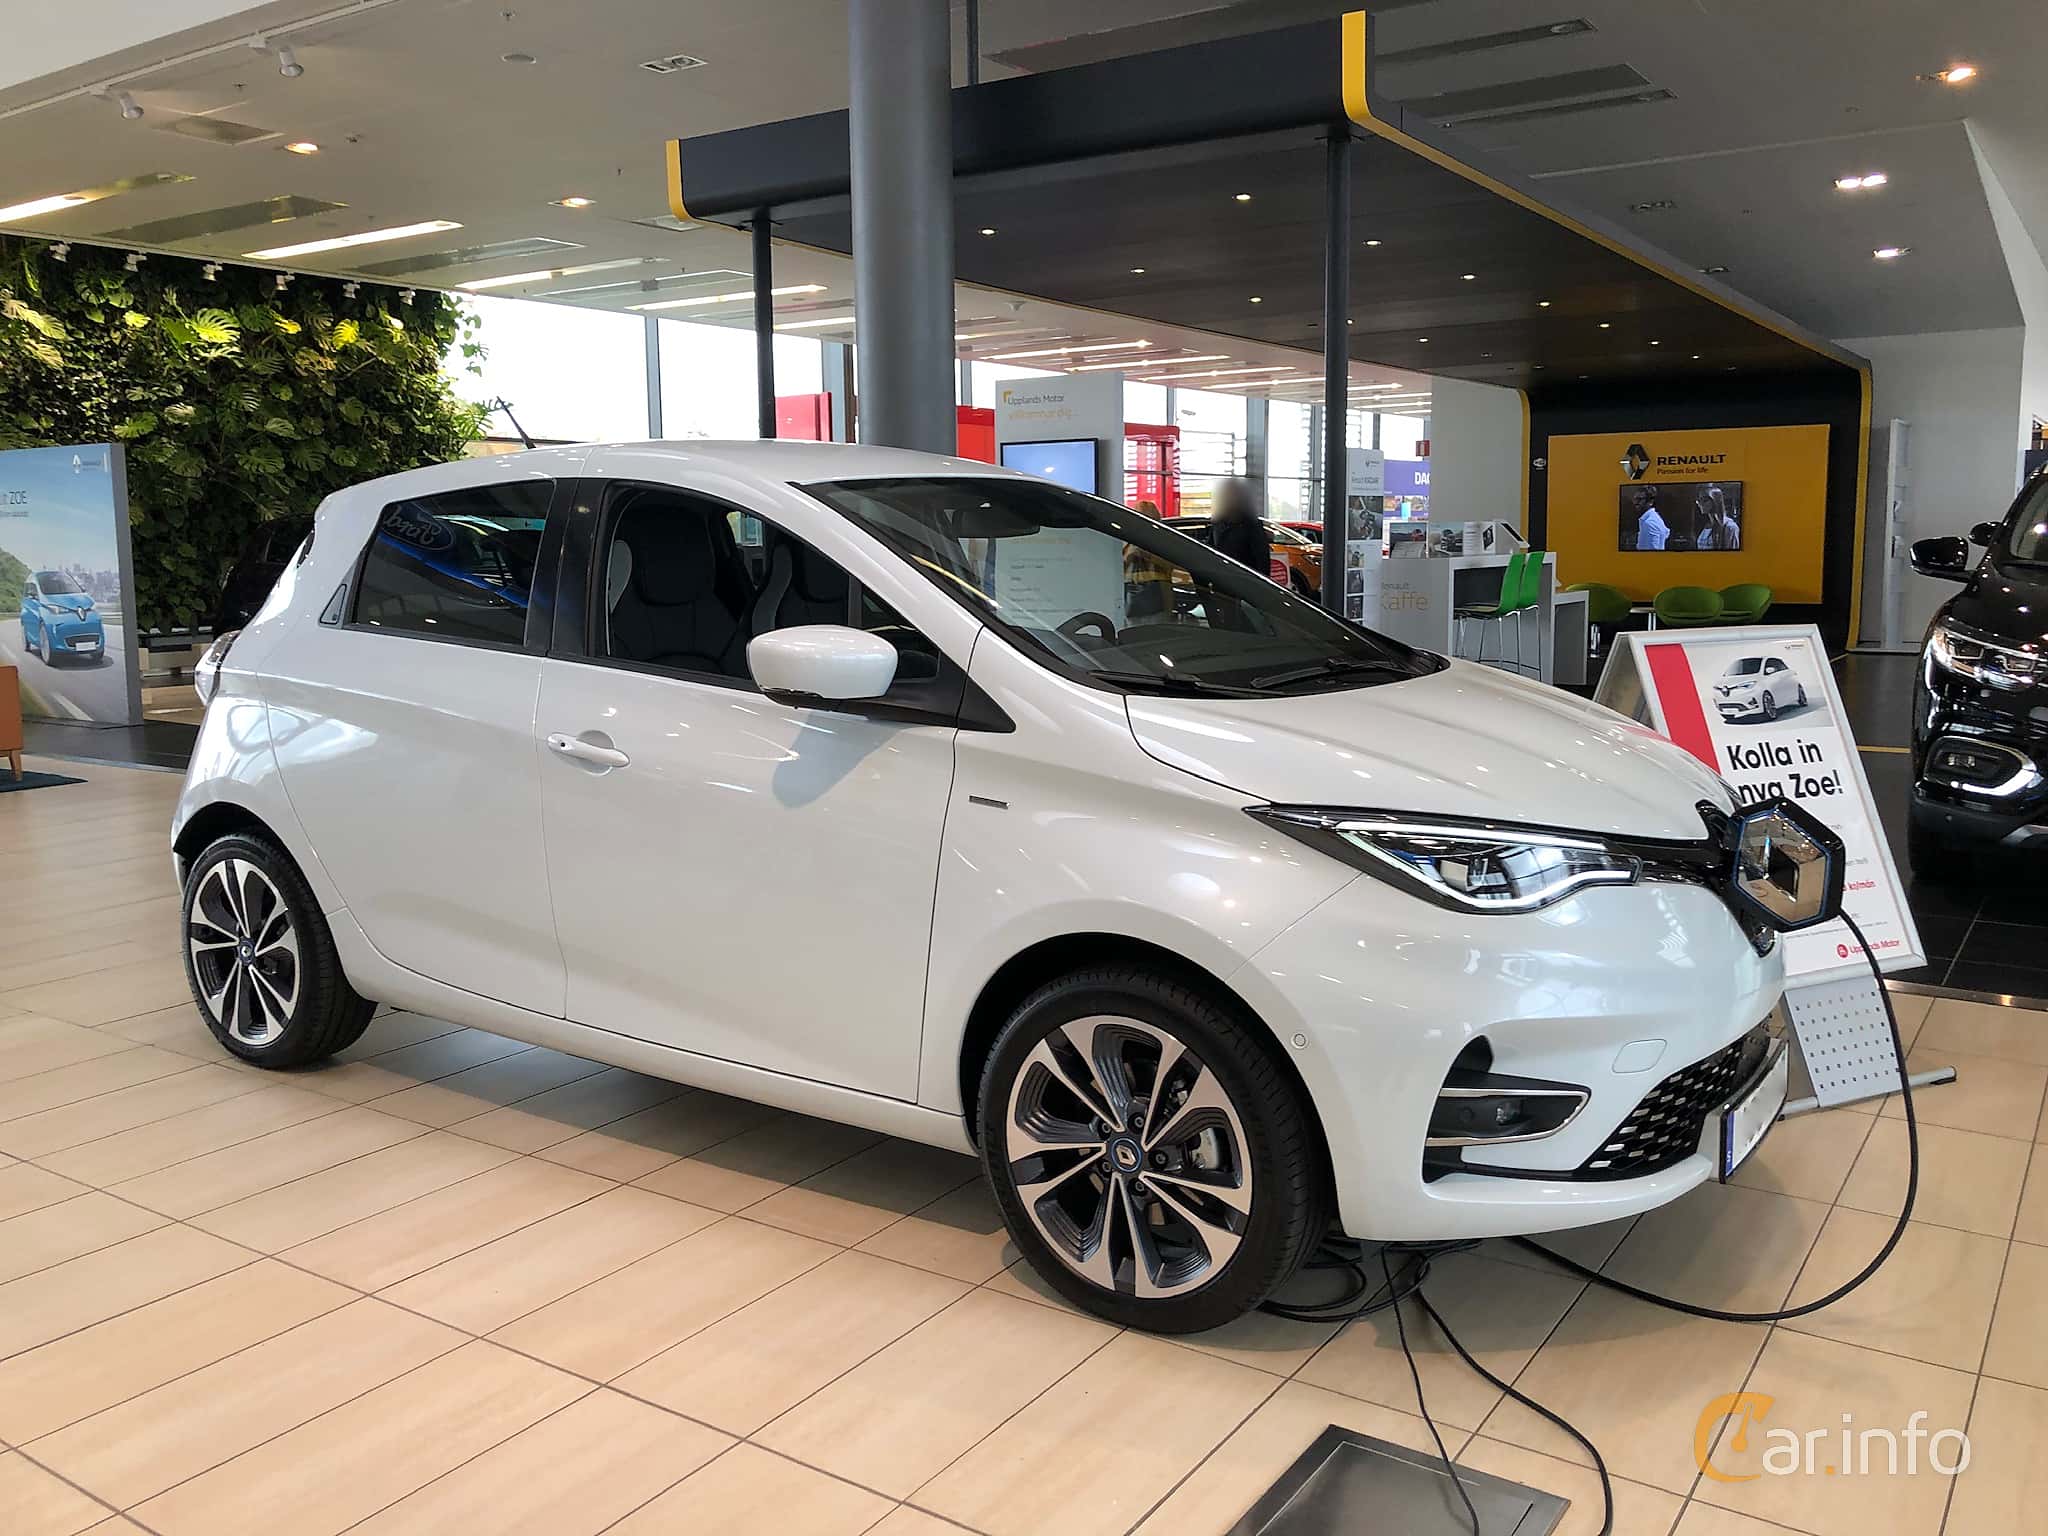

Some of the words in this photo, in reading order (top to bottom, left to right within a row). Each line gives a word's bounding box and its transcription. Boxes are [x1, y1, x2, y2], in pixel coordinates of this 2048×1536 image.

[1007, 395, 1041, 406] Upplands
[1043, 394, 1065, 403] Motor
[1657, 454, 1726, 466] RENAULT
[1657, 467, 1684, 475] Passion
[9, 490, 28, 505] ZOE
[1726, 742, 1793, 770] Kolla
[1797, 739, 1823, 763] in
[1788, 769, 1844, 798] Zoe!
[1880, 939, 1900, 949] Motor
